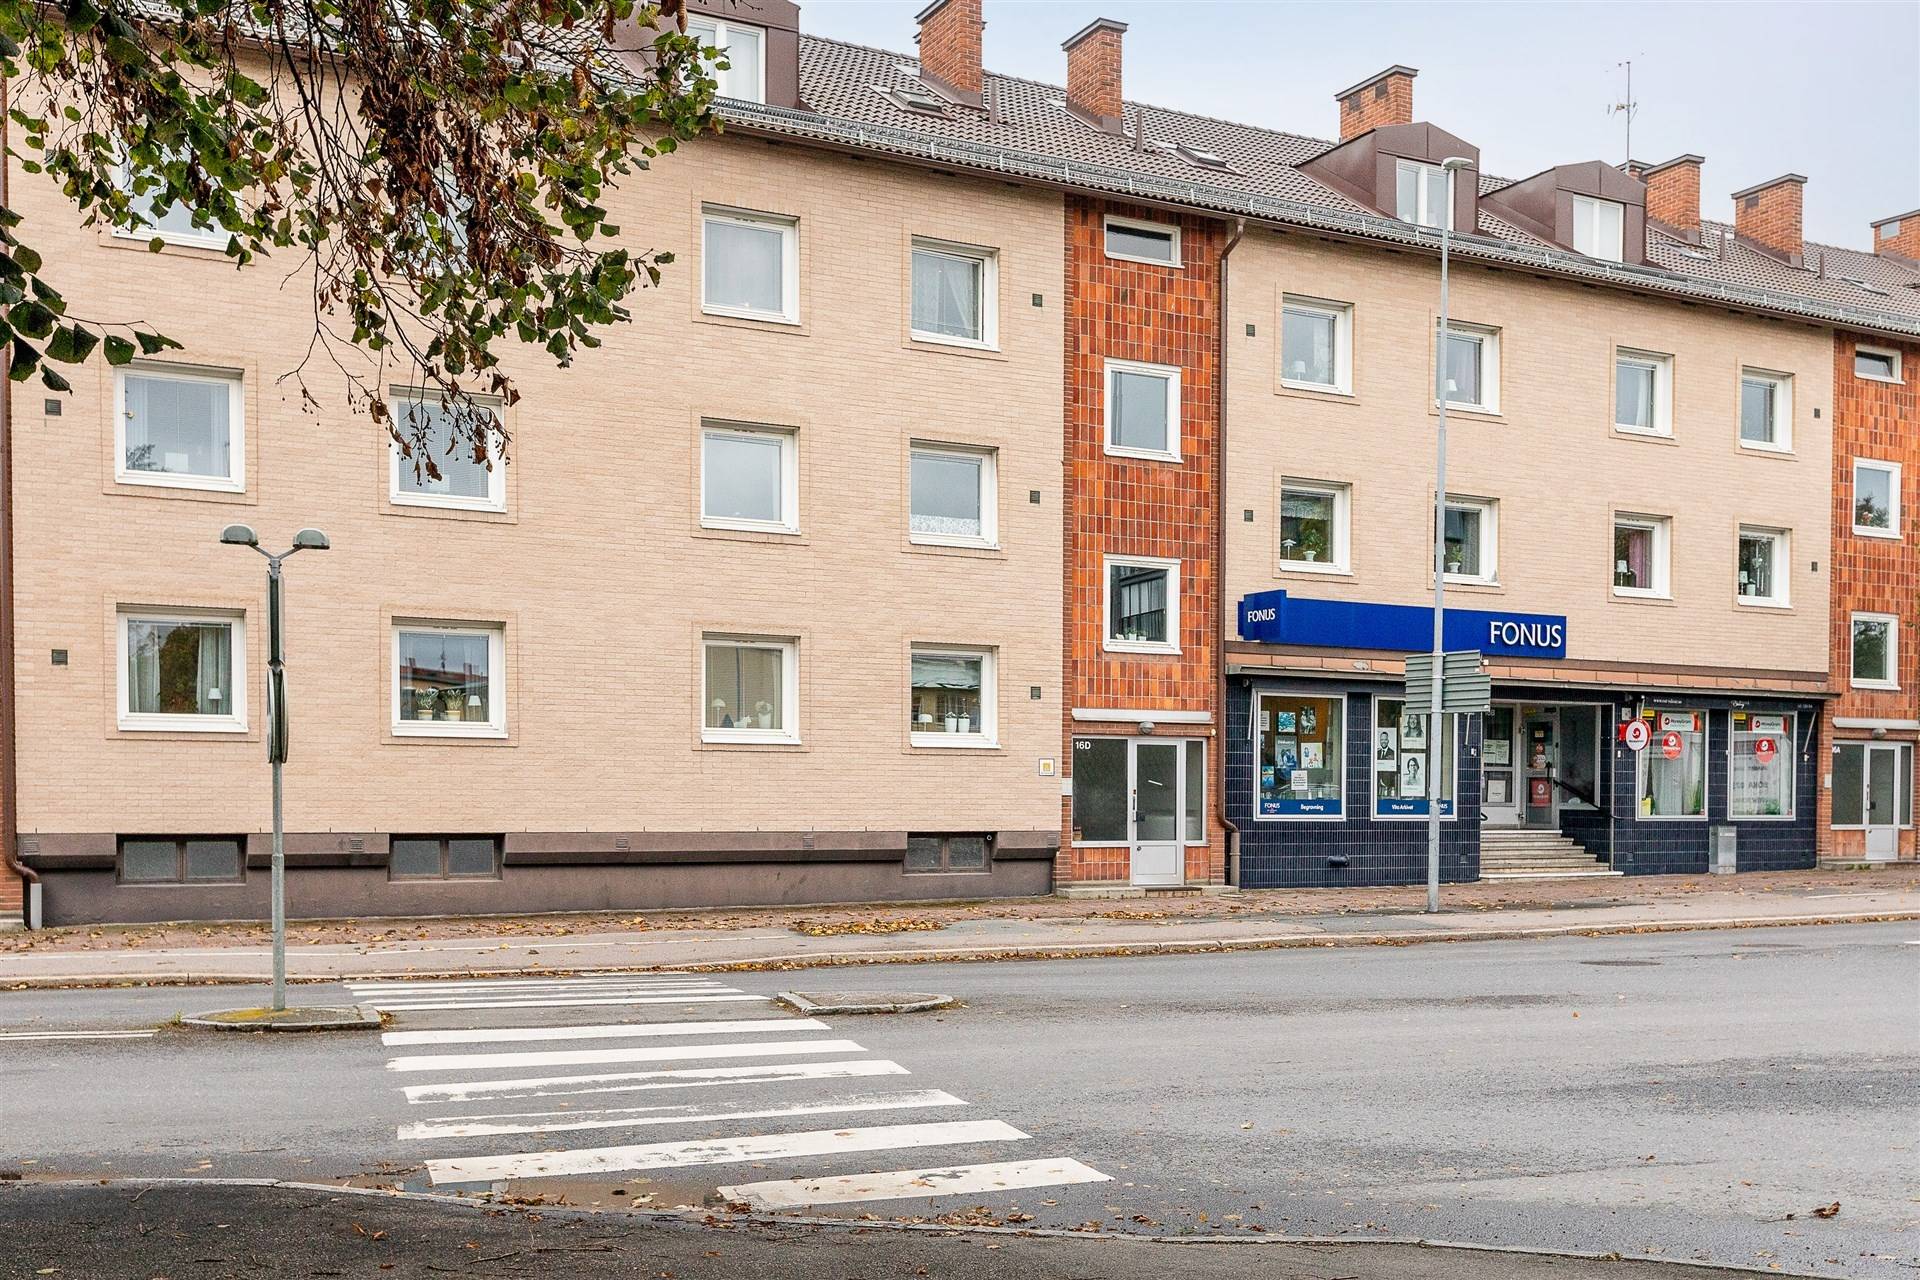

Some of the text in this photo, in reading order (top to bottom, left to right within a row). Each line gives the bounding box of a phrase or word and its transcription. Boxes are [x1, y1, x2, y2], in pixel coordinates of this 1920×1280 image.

[1247, 608, 1276, 623] FONUS
[1489, 621, 1562, 648] FONUS
[1075, 741, 1091, 750] 16D
[1300, 803, 1324, 812] Begravning
